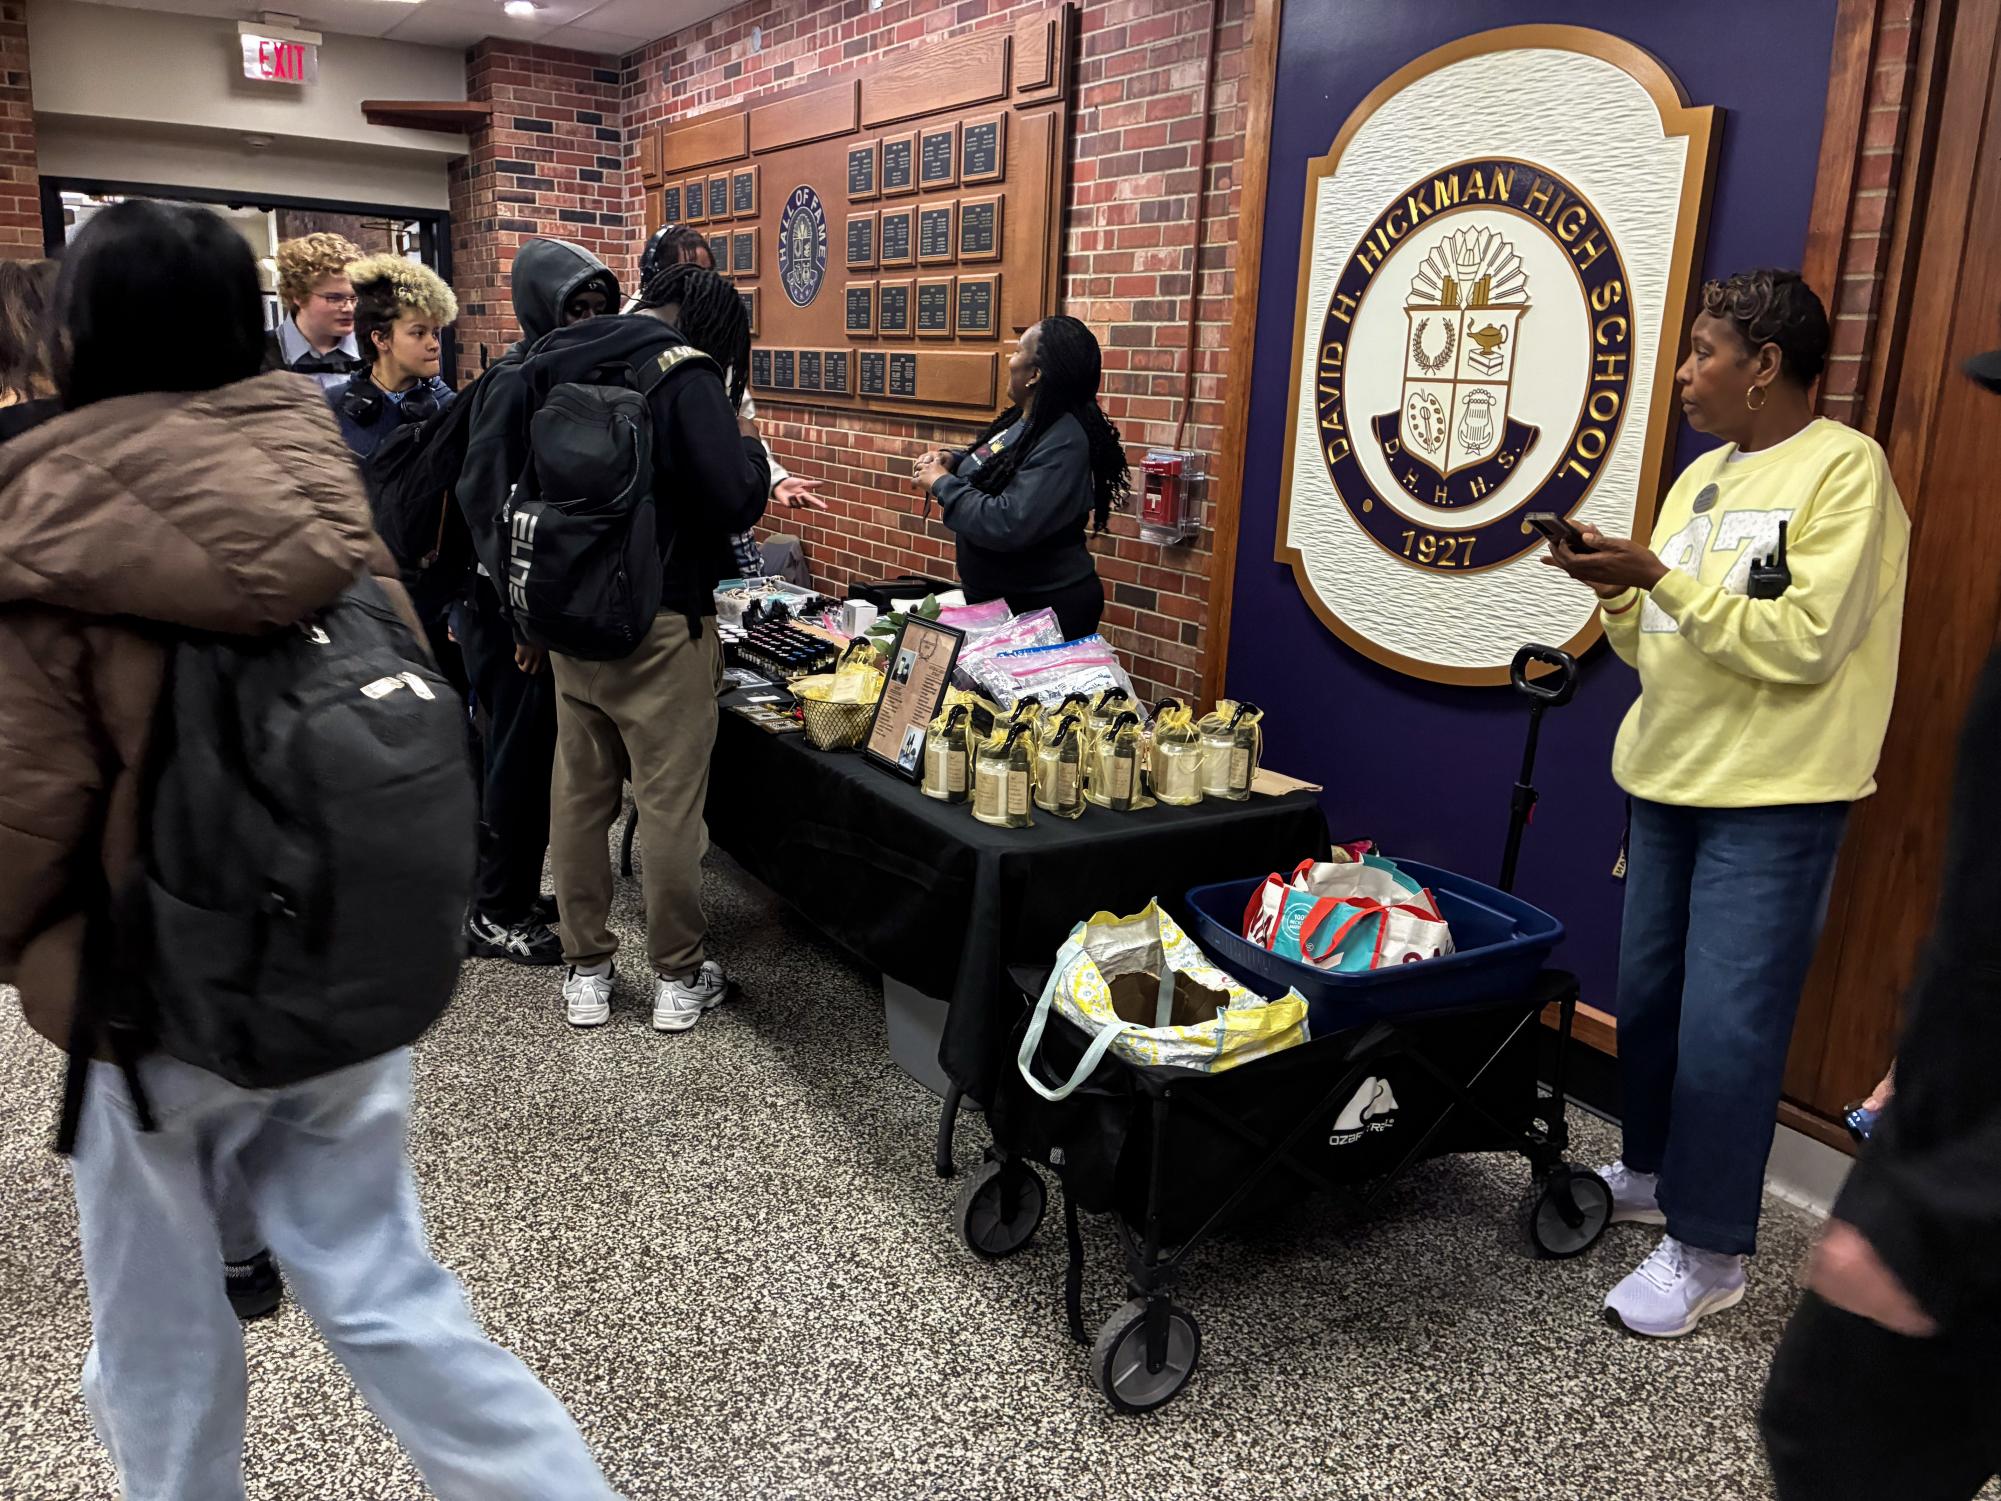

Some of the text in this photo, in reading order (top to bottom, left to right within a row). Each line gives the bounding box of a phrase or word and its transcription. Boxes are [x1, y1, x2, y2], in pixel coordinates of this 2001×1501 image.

[259, 41, 304, 80] EXIT
[780, 188, 826, 261] HALL OF FAME
[1320, 166, 1628, 482] DAVID H. HICKMAN HIGH SCHOOL
[509, 511, 539, 611] ELITE
[1402, 529, 1476, 567] 1927
